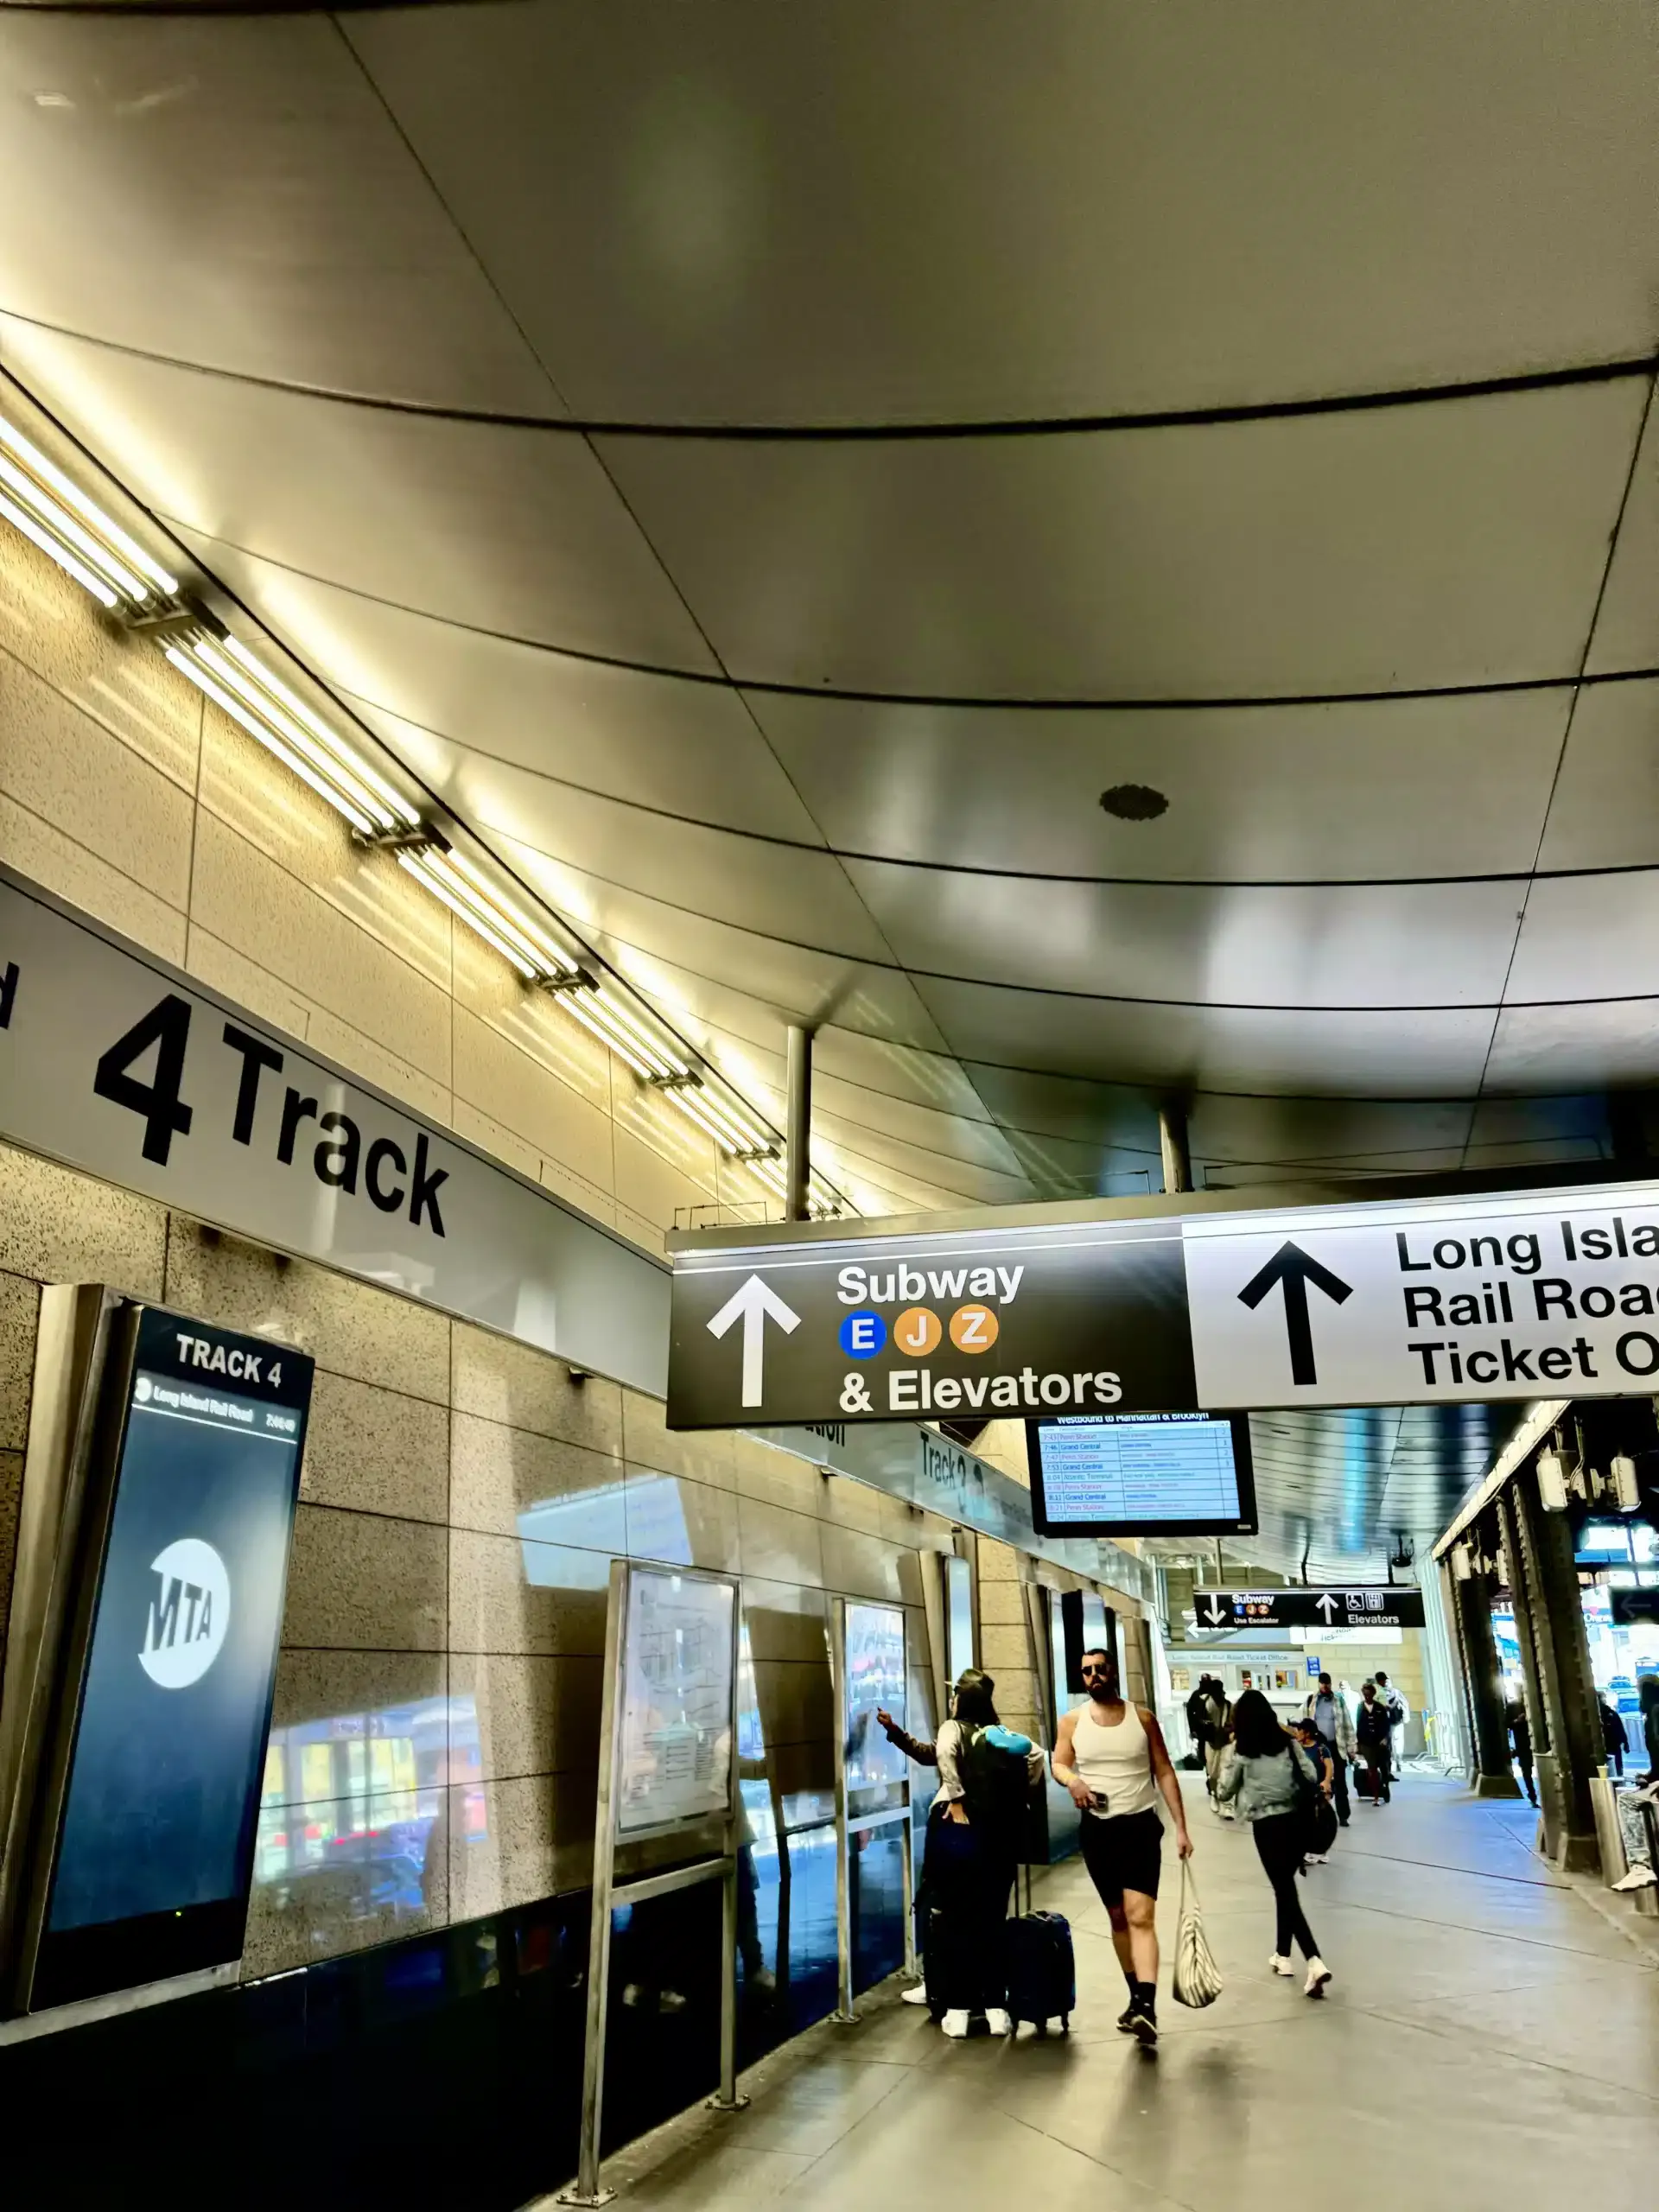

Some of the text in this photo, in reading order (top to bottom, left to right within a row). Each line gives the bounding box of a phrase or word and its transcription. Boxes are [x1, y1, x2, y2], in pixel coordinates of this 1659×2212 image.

[93, 993, 450, 1238] 4 Track
[1395, 1217, 1659, 1274] Long Isla
[836, 1264, 1025, 1306] Subway
[1403, 1278, 1659, 1328] Rail Roa
[961, 1311, 988, 1344] Z
[176, 1333, 282, 1389] TRACK 4
[1408, 1337, 1599, 1385] Ticket
[839, 1367, 1123, 1414] & Elevators
[920, 1431, 956, 1490] Track
[1232, 1593, 1274, 1606] Subway
[1347, 1613, 1400, 1624] Elevators
